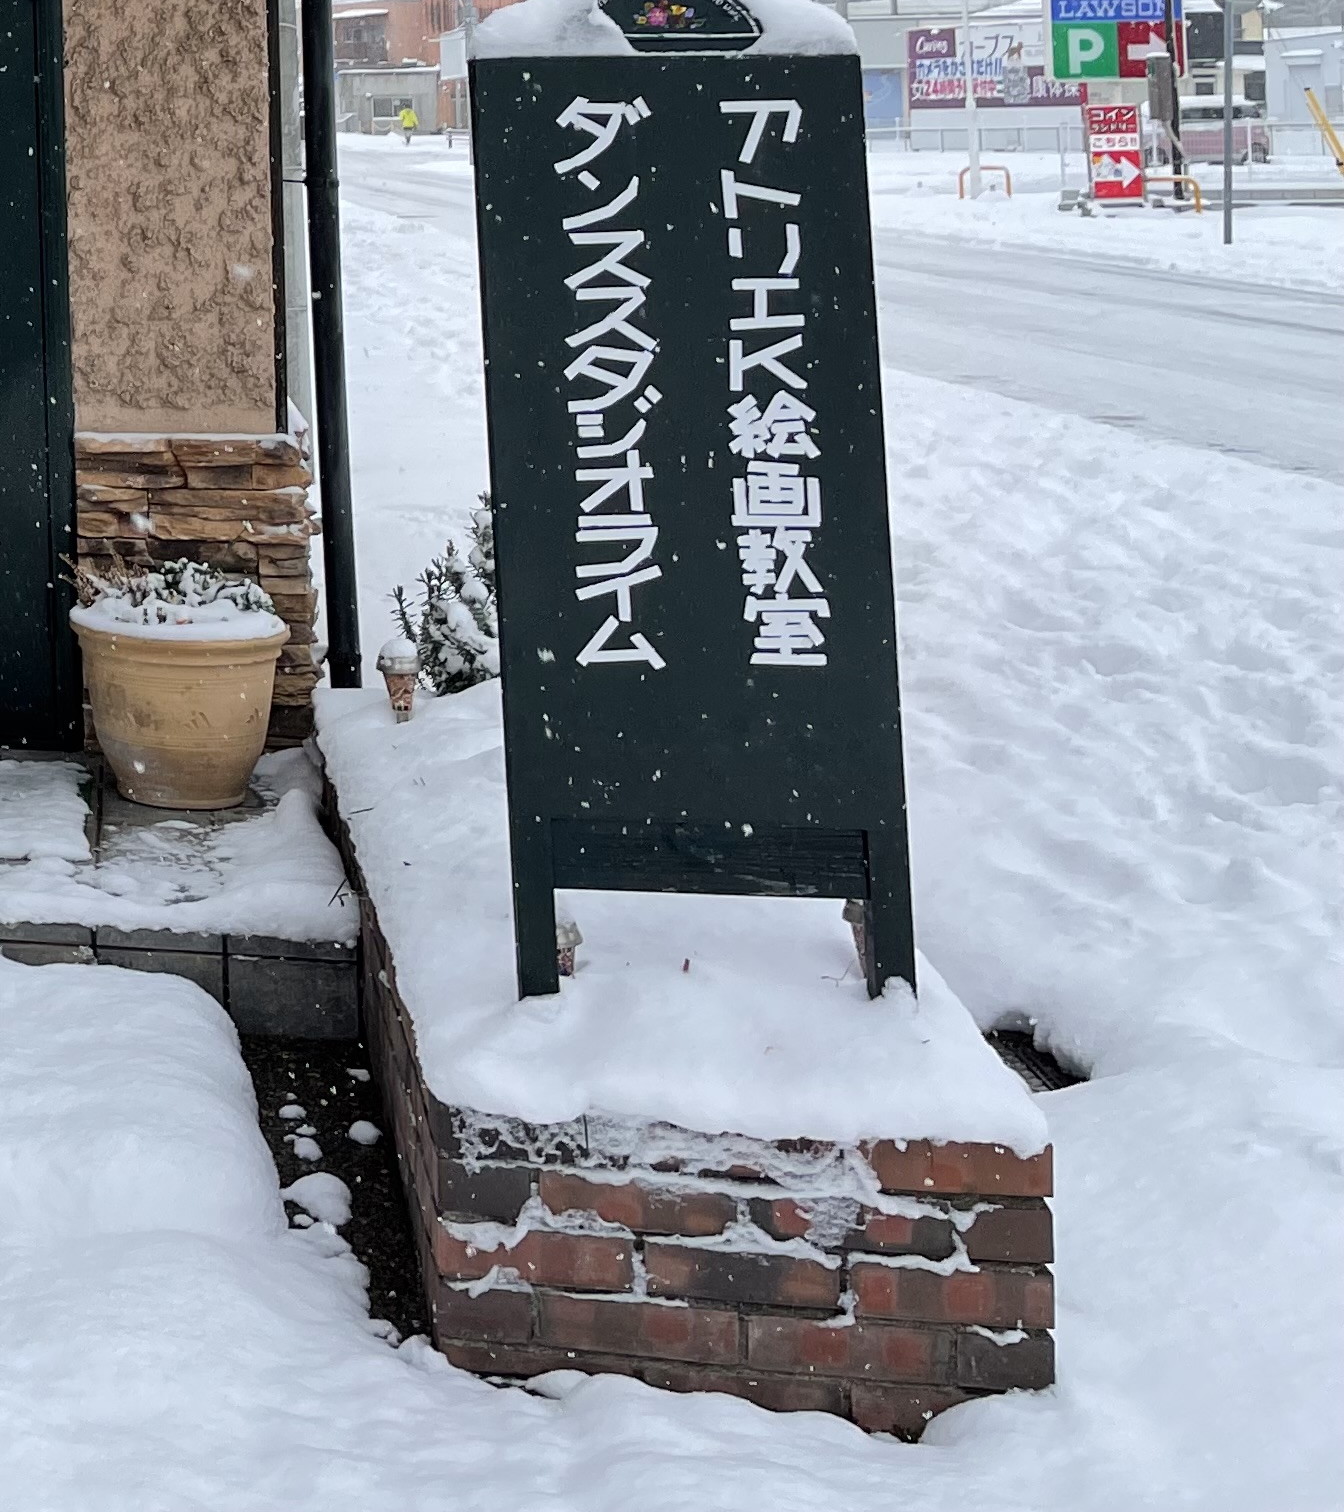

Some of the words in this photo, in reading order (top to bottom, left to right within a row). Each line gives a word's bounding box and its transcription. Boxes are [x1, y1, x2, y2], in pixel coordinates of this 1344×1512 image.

[1067, 28, 1105, 75] P
[1091, 108, 1135, 122] コイン
[554, 95, 667, 671] ダンススタジオライム
